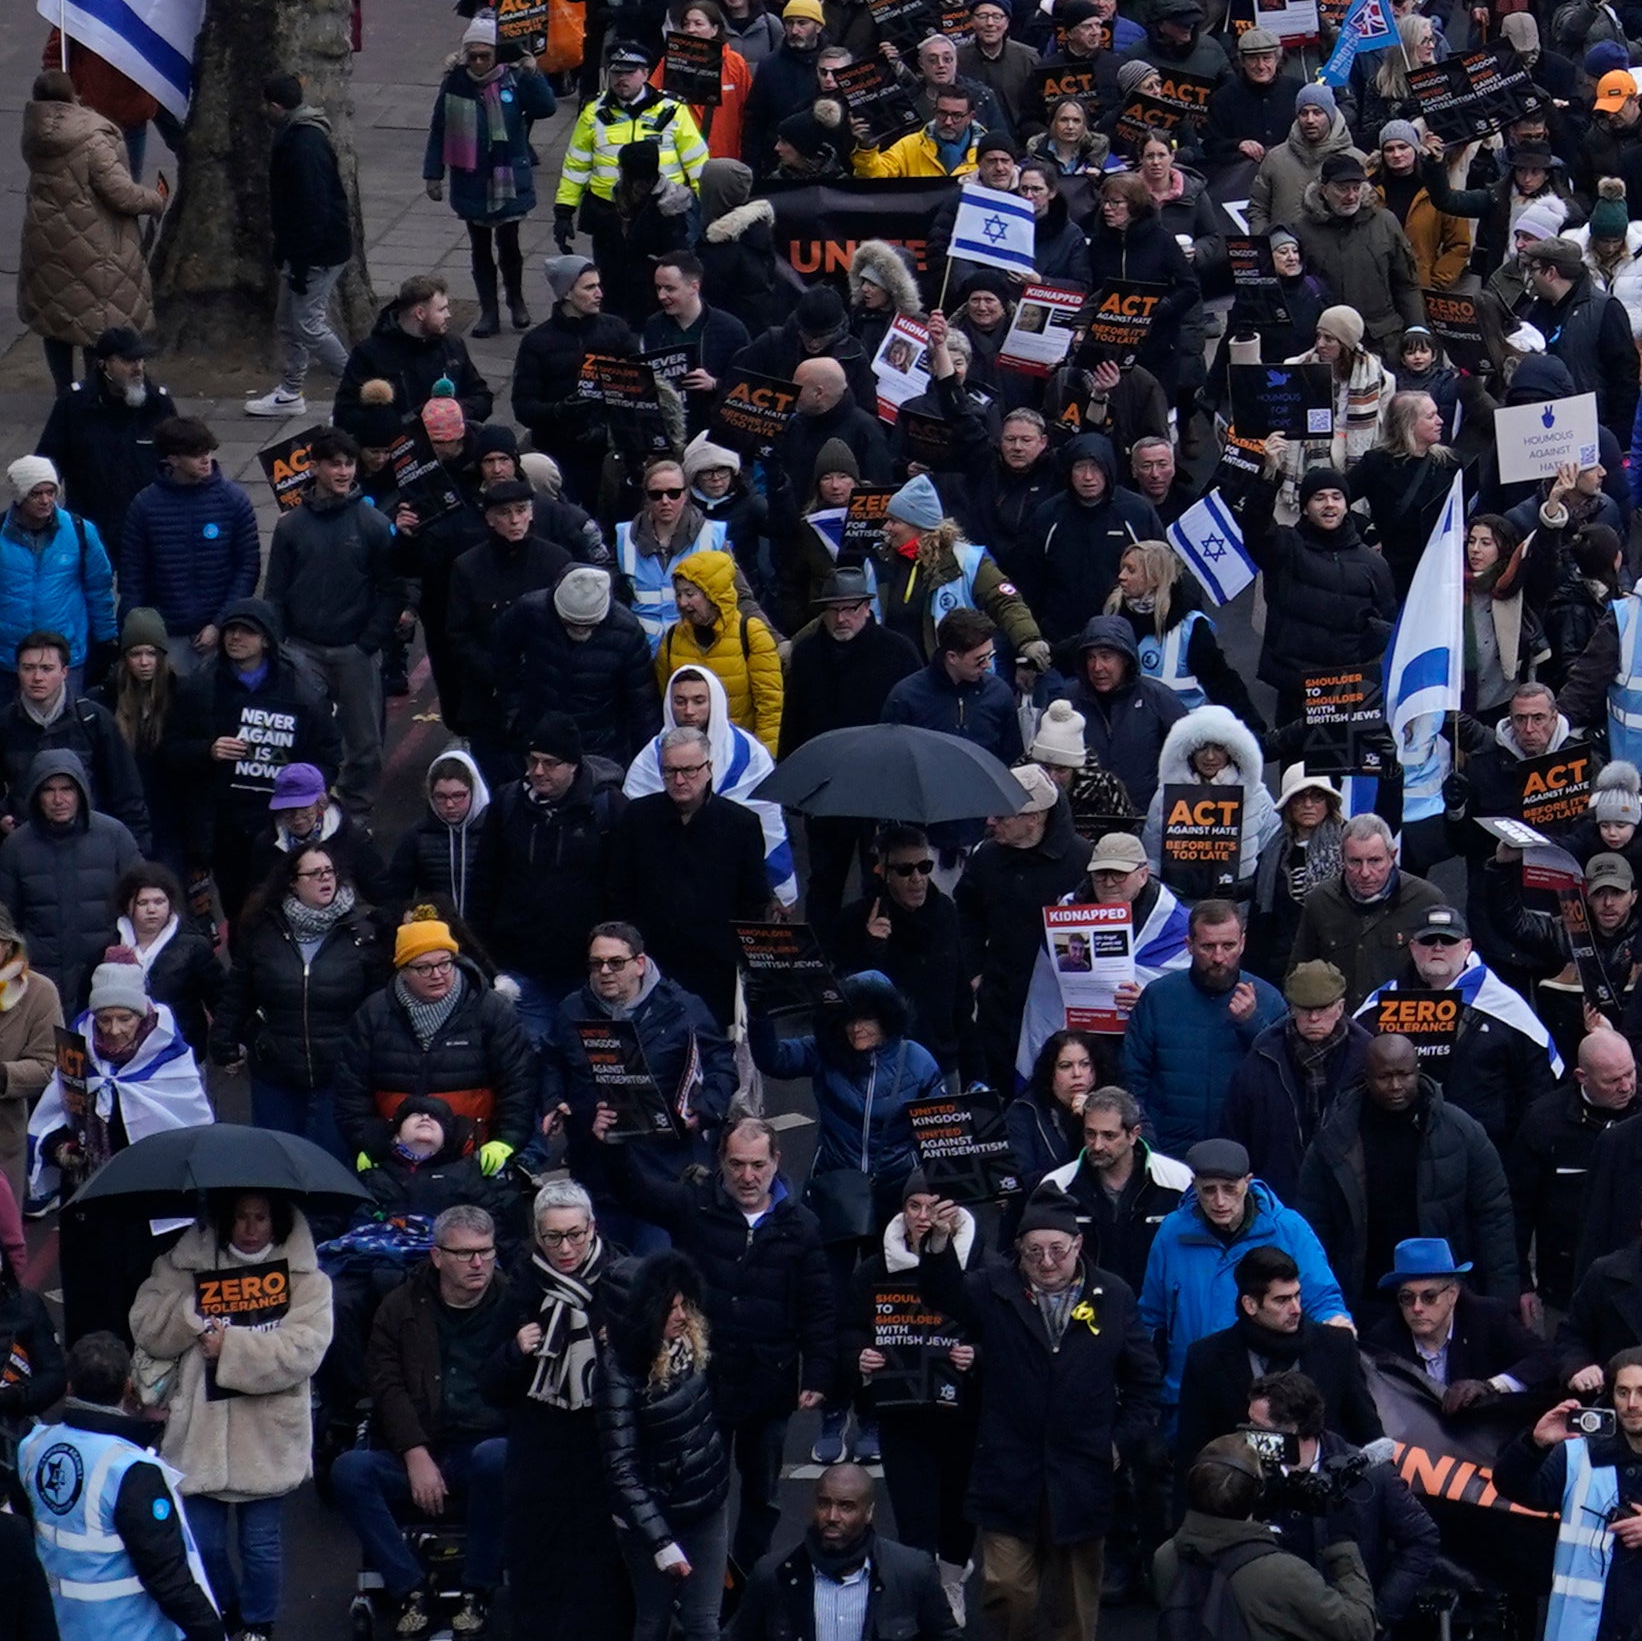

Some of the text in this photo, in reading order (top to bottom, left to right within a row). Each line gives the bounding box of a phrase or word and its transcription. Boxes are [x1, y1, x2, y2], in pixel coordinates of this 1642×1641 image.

[1044, 73, 1094, 97] ACT
[1161, 78, 1210, 105] ACT
[1026, 288, 1084, 306] KIDNAPPED
[1099, 292, 1159, 318] ACT
[1523, 431, 1575, 447] HOUMOUS
[1529, 446, 1571, 460] AGAINST
[240, 708, 296, 732] NEVER
[1306, 714, 1349, 726] BRITISH
[237, 726, 294, 749] AGAIN
[1523, 758, 1588, 797] ACT
[1167, 800, 1239, 828] ACT
[1049, 909, 1127, 924] KIDNAPPED
[1380, 1000, 1457, 1022] ZERO
[912, 1113, 973, 1128] KINGDOM
[920, 1136, 974, 1150] AGAINST
[923, 1142, 1010, 1160] ANTISEMITISM
[200, 1271, 288, 1304] ZERO
[204, 1292, 288, 1315] TOLERANCE
[876, 1304, 894, 1315] TO
[876, 1326, 909, 1336] WITH
[876, 1336, 923, 1347] BRITISH
